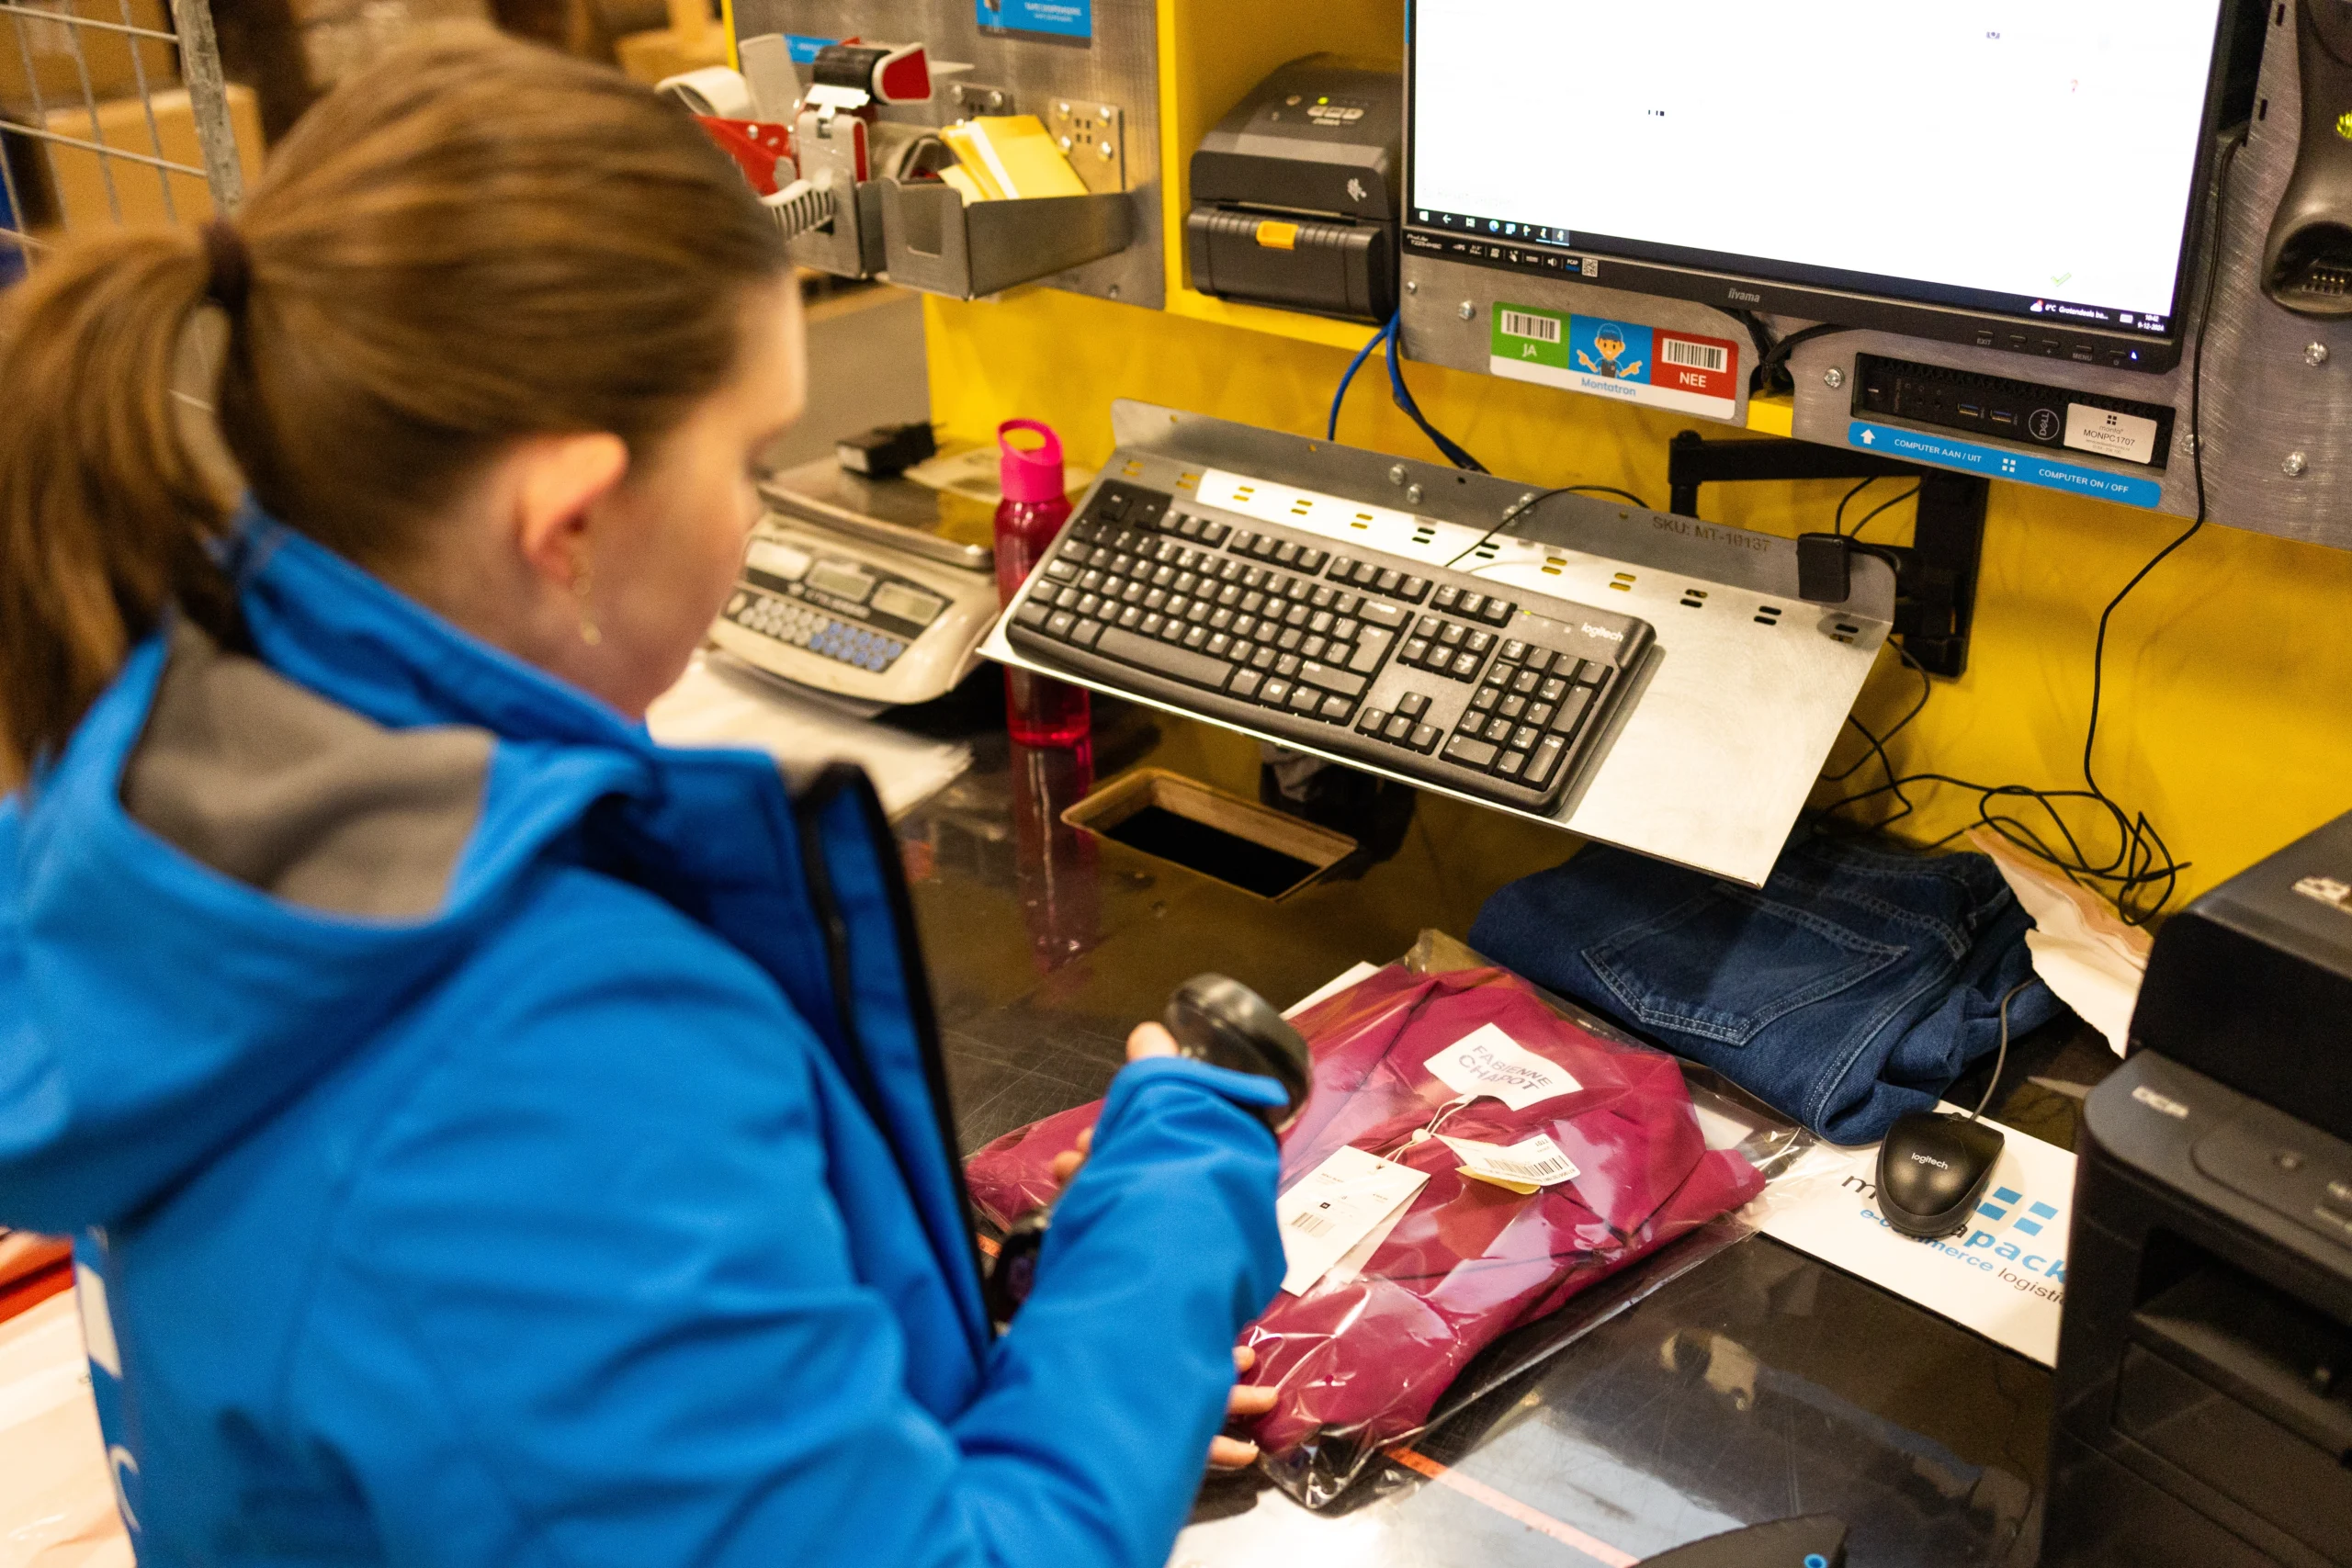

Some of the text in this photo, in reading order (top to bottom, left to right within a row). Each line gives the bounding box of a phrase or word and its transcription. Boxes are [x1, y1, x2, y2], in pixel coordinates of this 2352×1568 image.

[1728, 288, 1760, 303] iiyama
[1521, 344, 1538, 358] JA
[1977, 338, 1992, 346] EXIT
[2072, 352, 2093, 362] MENU
[1581, 377, 1636, 397] Montatron
[1679, 371, 1707, 389] NEE
[2039, 412, 2050, 436] DELL
[2083, 428, 2136, 446] MONPC1707
[1894, 438, 1940, 457] COMPUTER
[1941, 447, 1962, 460] AAN
[1967, 452, 1982, 464] UIT
[2038, 468, 2088, 487] COMPUTER
[2089, 478, 2105, 490] ON
[2111, 482, 2130, 494] OFF
[1653, 516, 1690, 536] SKU:
[1580, 622, 1624, 643] logitech
[1458, 1054, 1541, 1090] CHAPOT
[1472, 1045, 1554, 1087] FABIENNE
[1911, 1152, 1949, 1171] logitech
